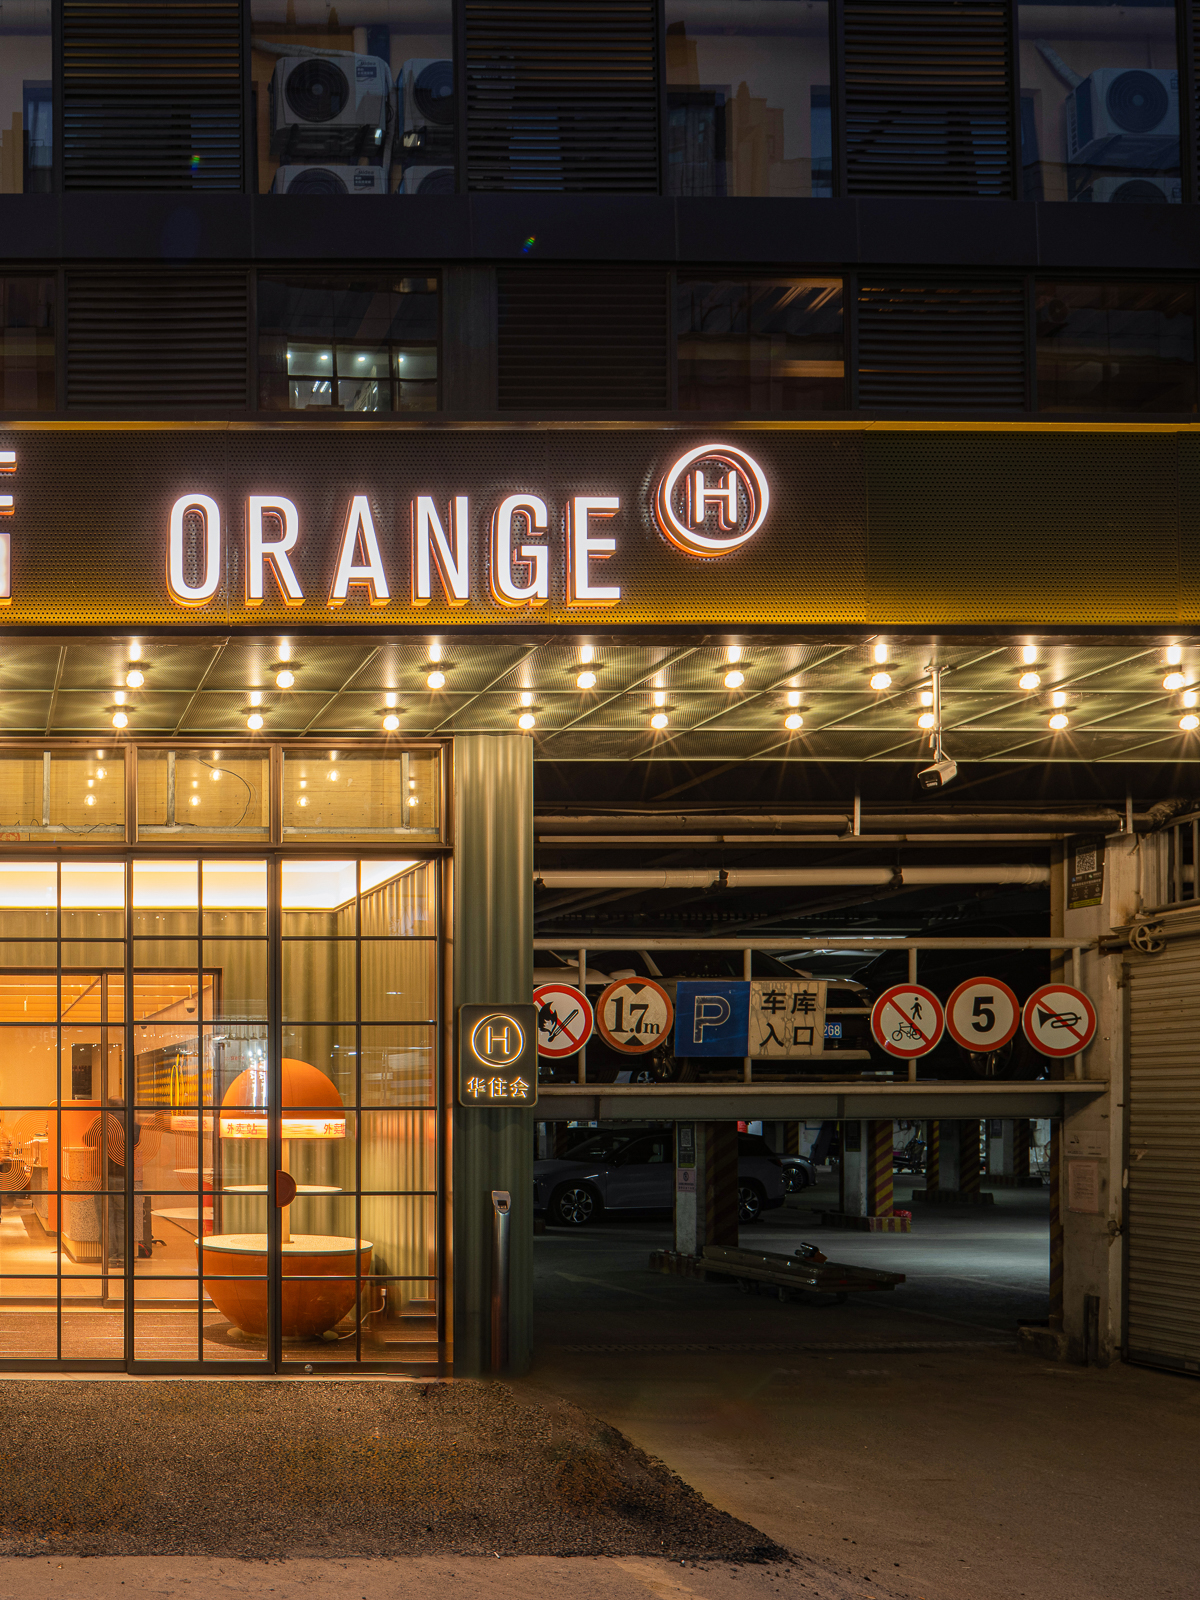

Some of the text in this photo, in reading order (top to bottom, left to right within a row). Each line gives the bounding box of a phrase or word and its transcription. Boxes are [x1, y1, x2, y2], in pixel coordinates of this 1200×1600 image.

[168, 493, 621, 602] ORANGE
[609, 996, 661, 1035] 1.7m
[761, 989, 817, 1015] 车库
[971, 995, 996, 1033] 5
[693, 995, 731, 1044] P
[759, 1022, 815, 1048] 入口
[467, 1076, 531, 1098] 华住会
[226, 1123, 258, 1135] 外卖站
